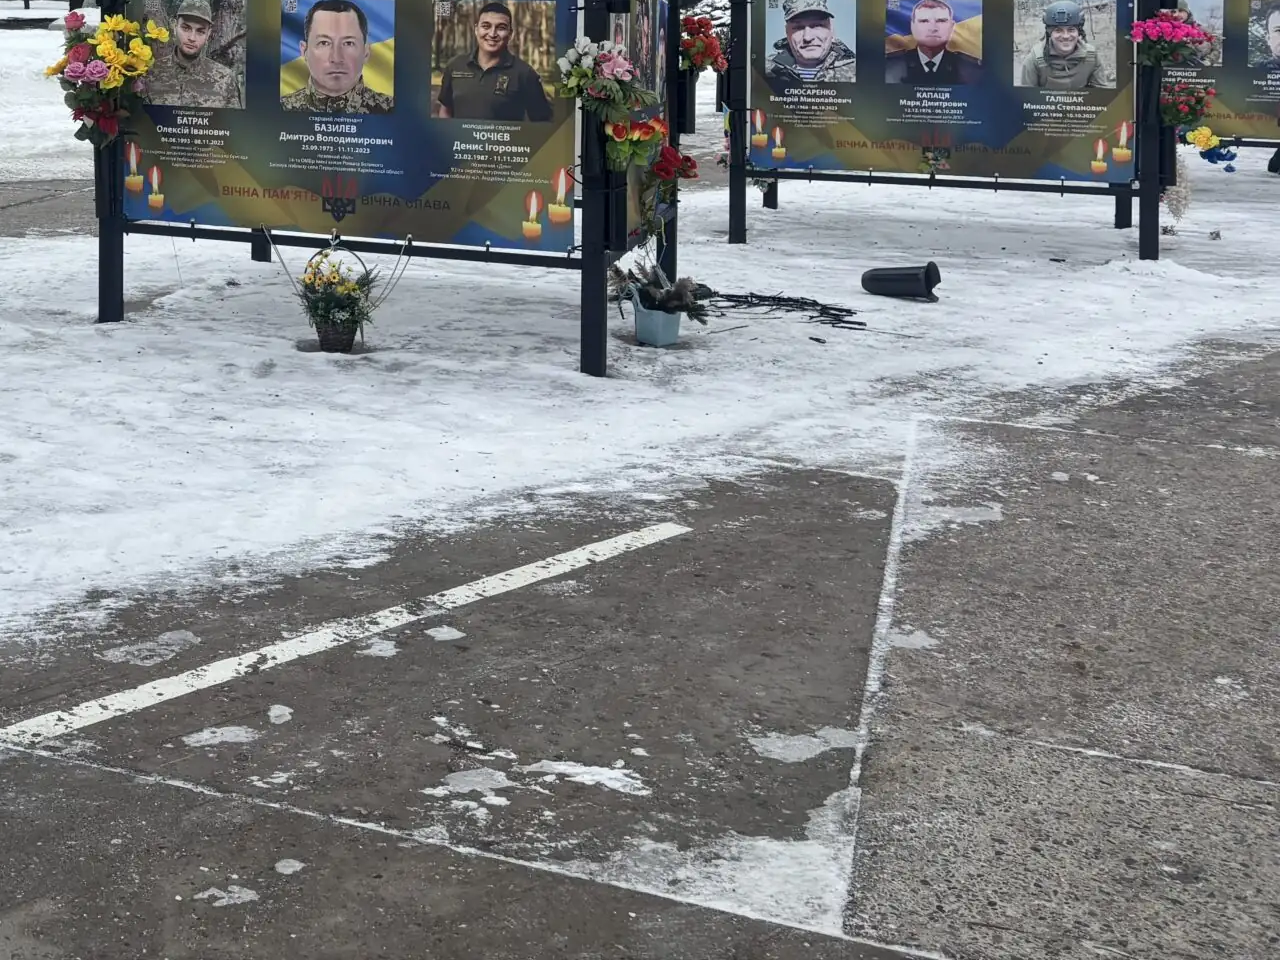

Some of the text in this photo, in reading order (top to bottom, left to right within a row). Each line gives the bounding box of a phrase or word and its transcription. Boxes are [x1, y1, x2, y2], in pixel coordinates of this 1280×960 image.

[784, 88, 837, 96] СЛЮСАРЕНКО
[916, 91, 950, 100] КАПАЦЯ
[769, 95, 852, 104] Валерій Миколайович
[899, 99, 968, 108] Марк Дмитрович
[1045, 95, 1084, 103] ГАЛІШАК
[1023, 102, 1108, 112] Микола Степанович
[176, 116, 209, 126] БАТРАК
[156, 125, 230, 137] Олексій Іванович
[314, 123, 357, 134] БАЗИЛЕВ
[279, 131, 394, 147] Дмитро Володимирович
[472, 131, 511, 142] ЧОЧІЄВ
[452, 141, 531, 154] Денис Ігорович
[836, 139, 919, 152] ВІЧНА ПАМ'ЯТЬ
[493, 155, 529, 163] 11.11.2023
[222, 185, 319, 202] ВІЧНА ПАМ'ЯТЬ
[361, 195, 451, 211] ВІЧНА СЛАВА
